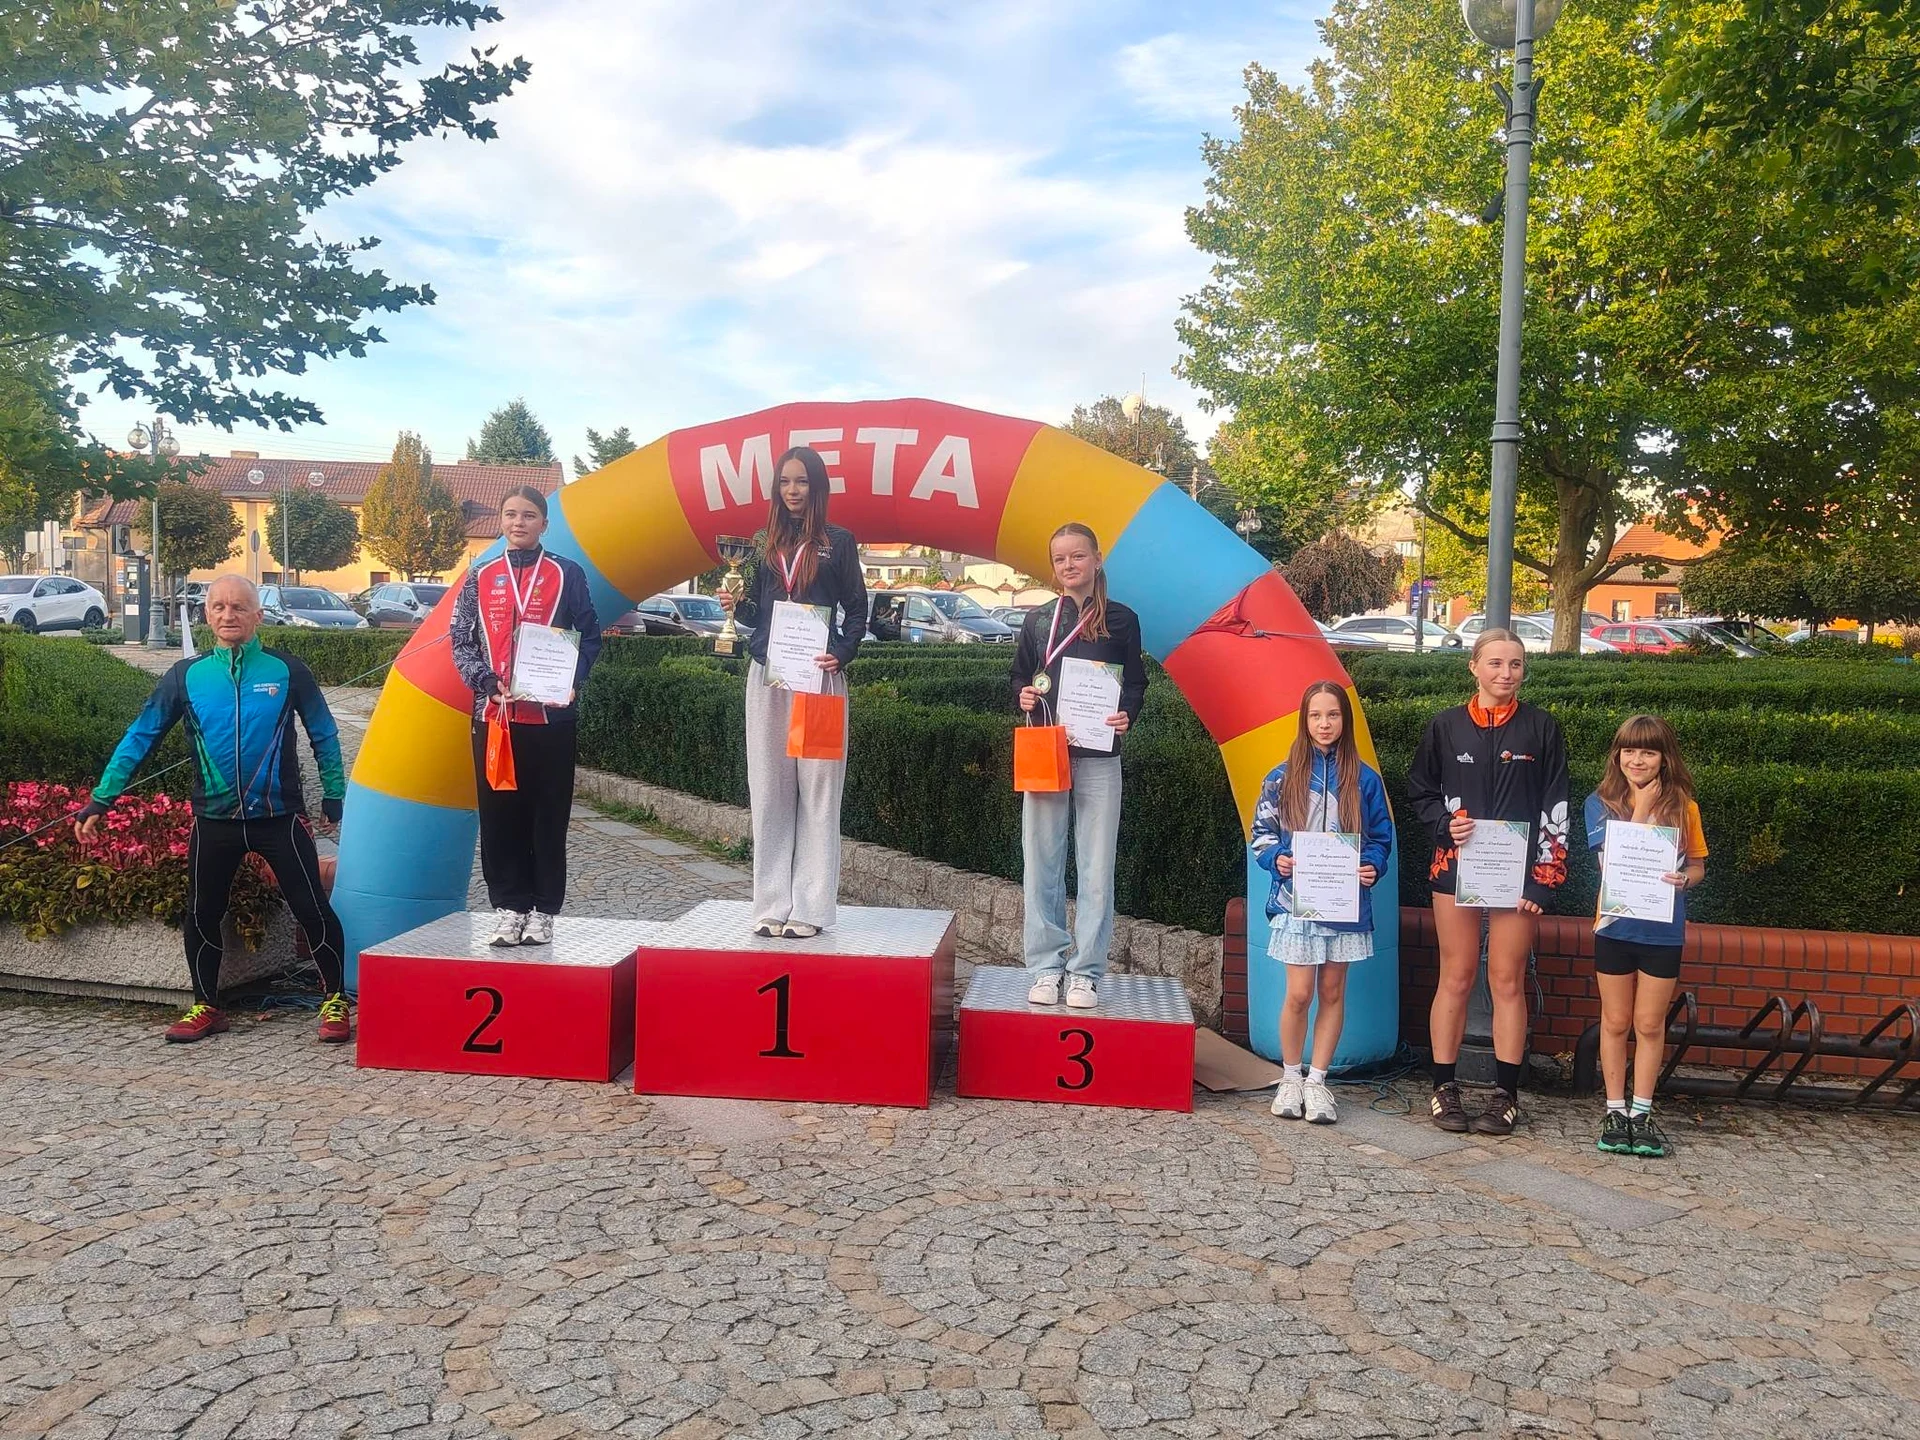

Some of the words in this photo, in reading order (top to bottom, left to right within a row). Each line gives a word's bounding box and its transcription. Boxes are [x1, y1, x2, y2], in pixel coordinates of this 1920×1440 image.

[700, 427, 979, 512] META
[461, 986, 505, 1055] 2
[756, 973, 805, 1060] 1
[1055, 1029, 1096, 1091] 3
